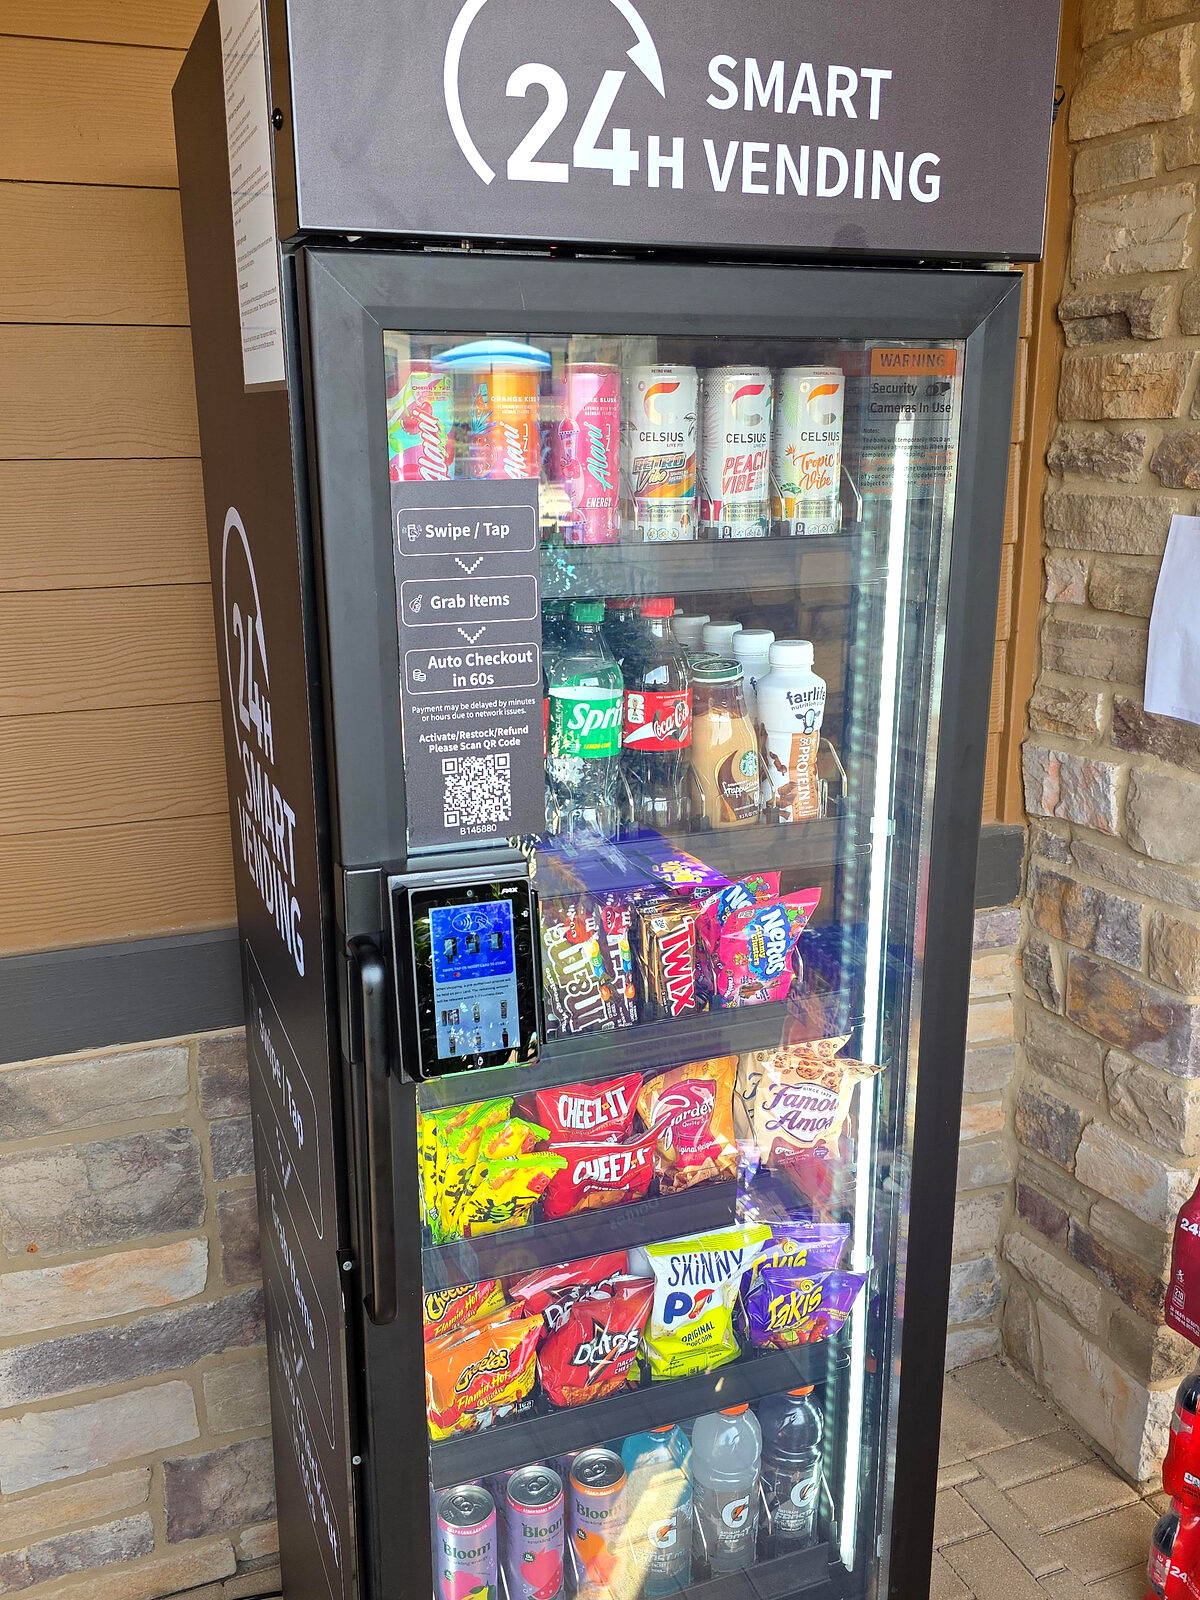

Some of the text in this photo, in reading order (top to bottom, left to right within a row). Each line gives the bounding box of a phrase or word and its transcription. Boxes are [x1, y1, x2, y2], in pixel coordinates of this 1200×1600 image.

[706, 54, 893, 121] SMART
[505, 62, 685, 190] 24H
[702, 138, 941, 203] VENDING
[880, 353, 946, 368] WARNING
[872, 382, 918, 396] Security
[870, 402, 952, 413] Cameras In Use
[639, 431, 685, 442] CELSIUS
[725, 433, 767, 444] CELSIUS
[800, 431, 840, 442] CELSIUS
[583, 421, 614, 491] Alani
[721, 471, 756, 495] VIBE
[798, 469, 833, 491] Vibe
[586, 497, 613, 508] ENERGY
[425, 521, 510, 540] Swipe / Tap
[430, 594, 510, 609] Grab Items
[427, 650, 533, 669] Auto Checkout
[452, 672, 495, 687] in 60s
[786, 686, 826, 706] fairlife
[791, 700, 816, 711] nutrition
[411, 697, 536, 715] Payment may be delayed by minutes
[431, 712, 451, 720] hours
[452, 711, 464, 719] due
[466, 710, 474, 718] to
[475, 708, 504, 717] network
[504, 706, 527, 715] issues.
[418, 724, 529, 743] Activate/Restock/Refund
[428, 737, 521, 754] Please Scan QR Code
[797, 745, 811, 801] PROTEIN
[242, 739, 297, 888] SMART
[460, 824, 497, 836] B145880
[237, 796, 305, 978] VENDING
[652, 916, 696, 1016] TWIX
[558, 1086, 629, 1130] CHEEZ-IT
[667, 1248, 744, 1287] SKINNY
[681, 1321, 716, 1342] ORIGINAL
[491, 1370, 511, 1388] Hot
[442, 1539, 491, 1560] Bloom
